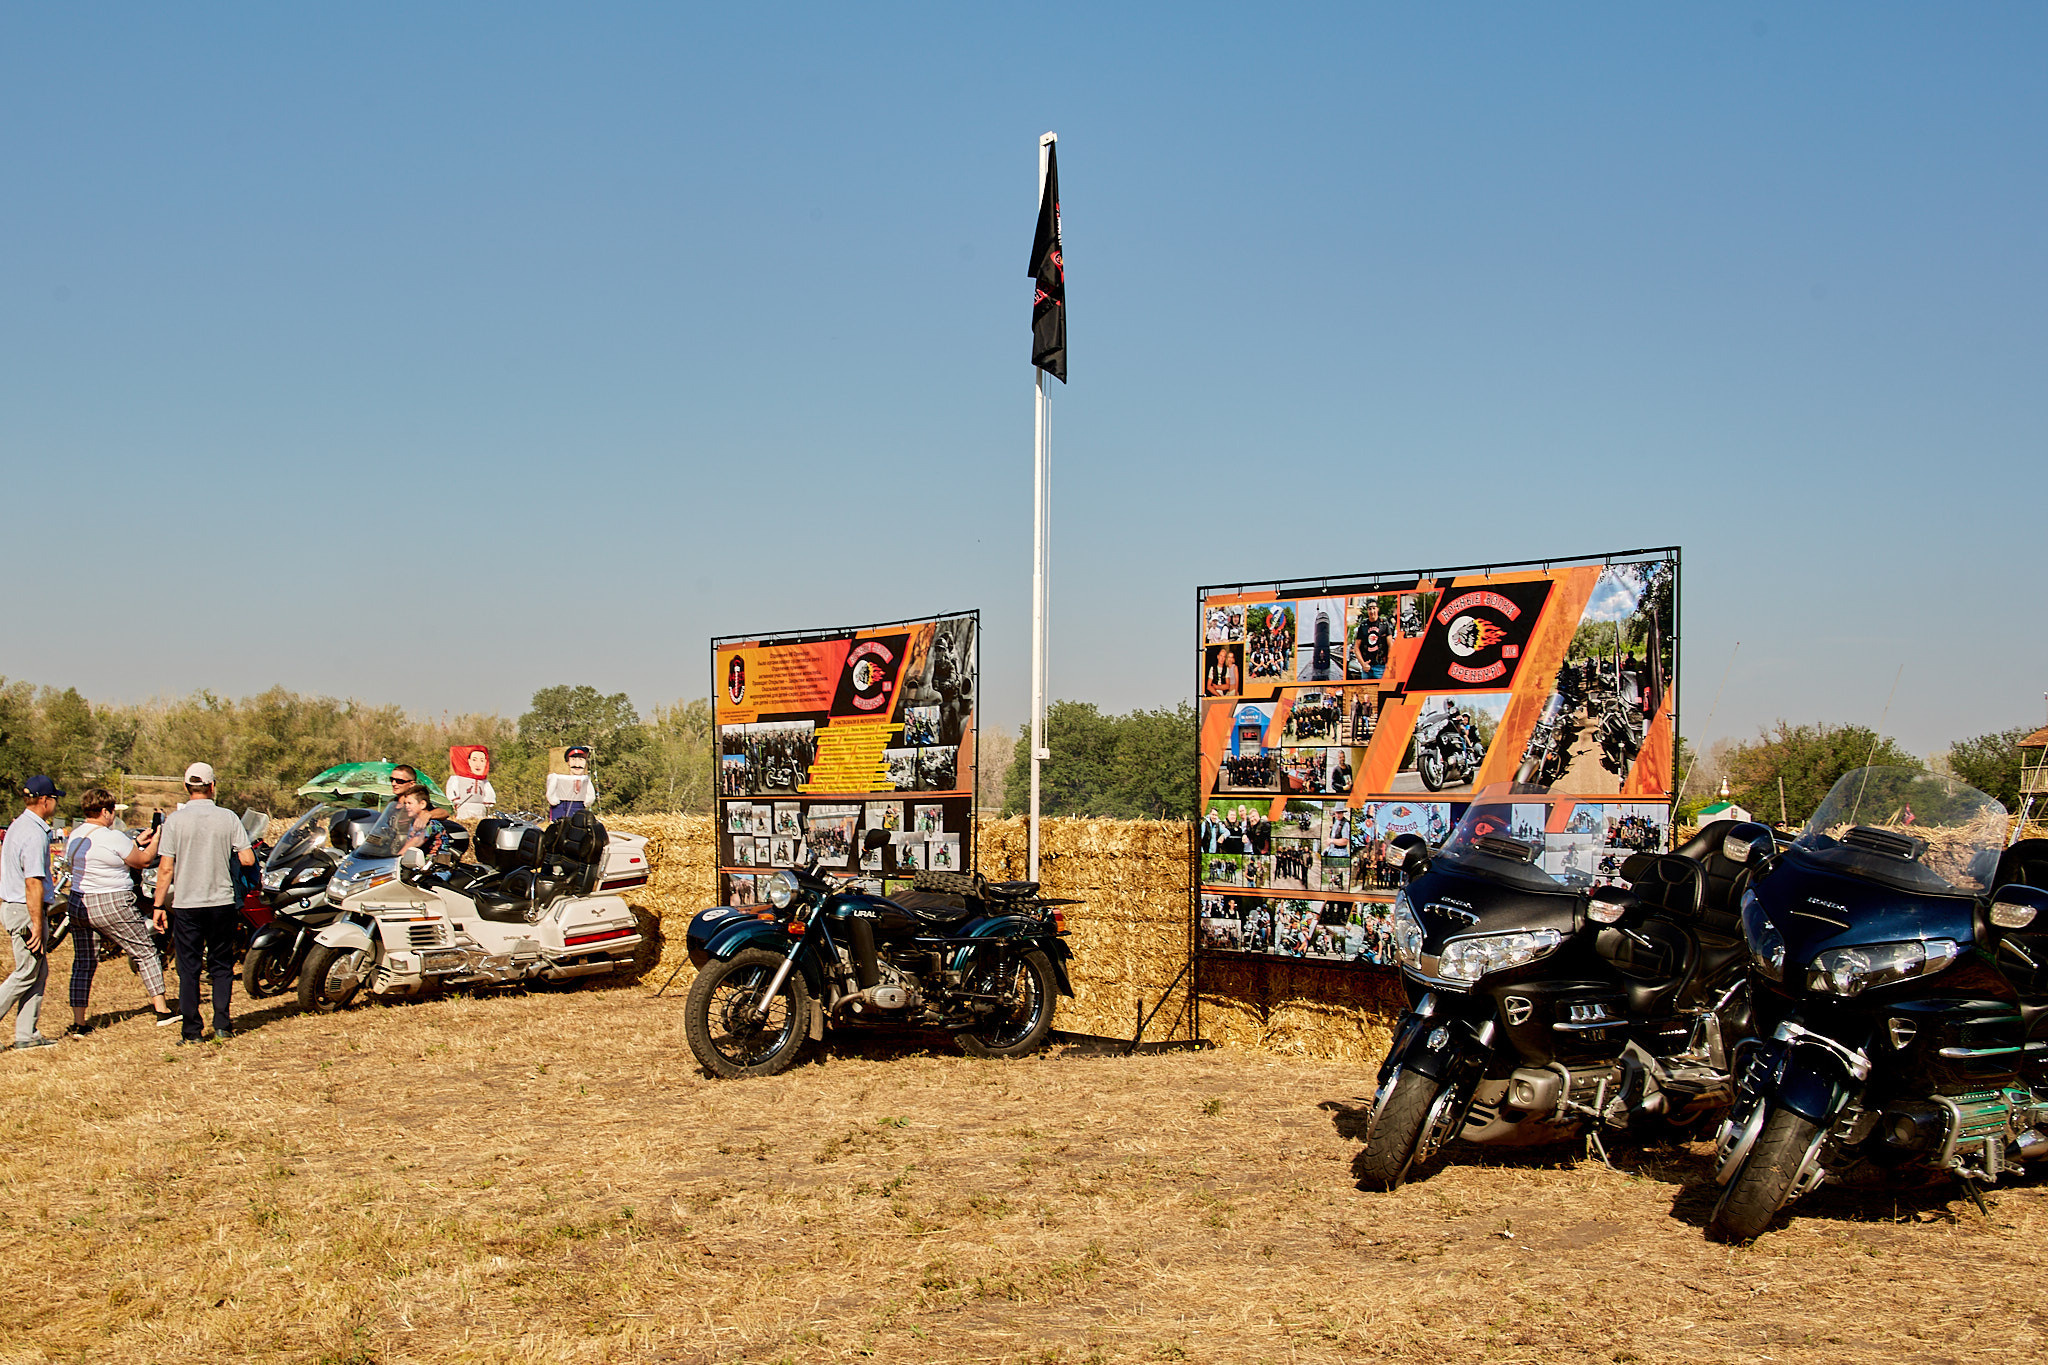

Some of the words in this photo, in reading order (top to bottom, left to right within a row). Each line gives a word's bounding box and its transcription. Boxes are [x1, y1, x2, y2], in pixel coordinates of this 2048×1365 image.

[1441, 593, 1481, 620] НОЧНЫЕ
[1485, 593, 1516, 617] ВОЛКИ
[1451, 662, 1502, 681] ОРЕНБУРГ
[1807, 897, 1848, 912] HONDA
[853, 910, 877, 918] URAL
